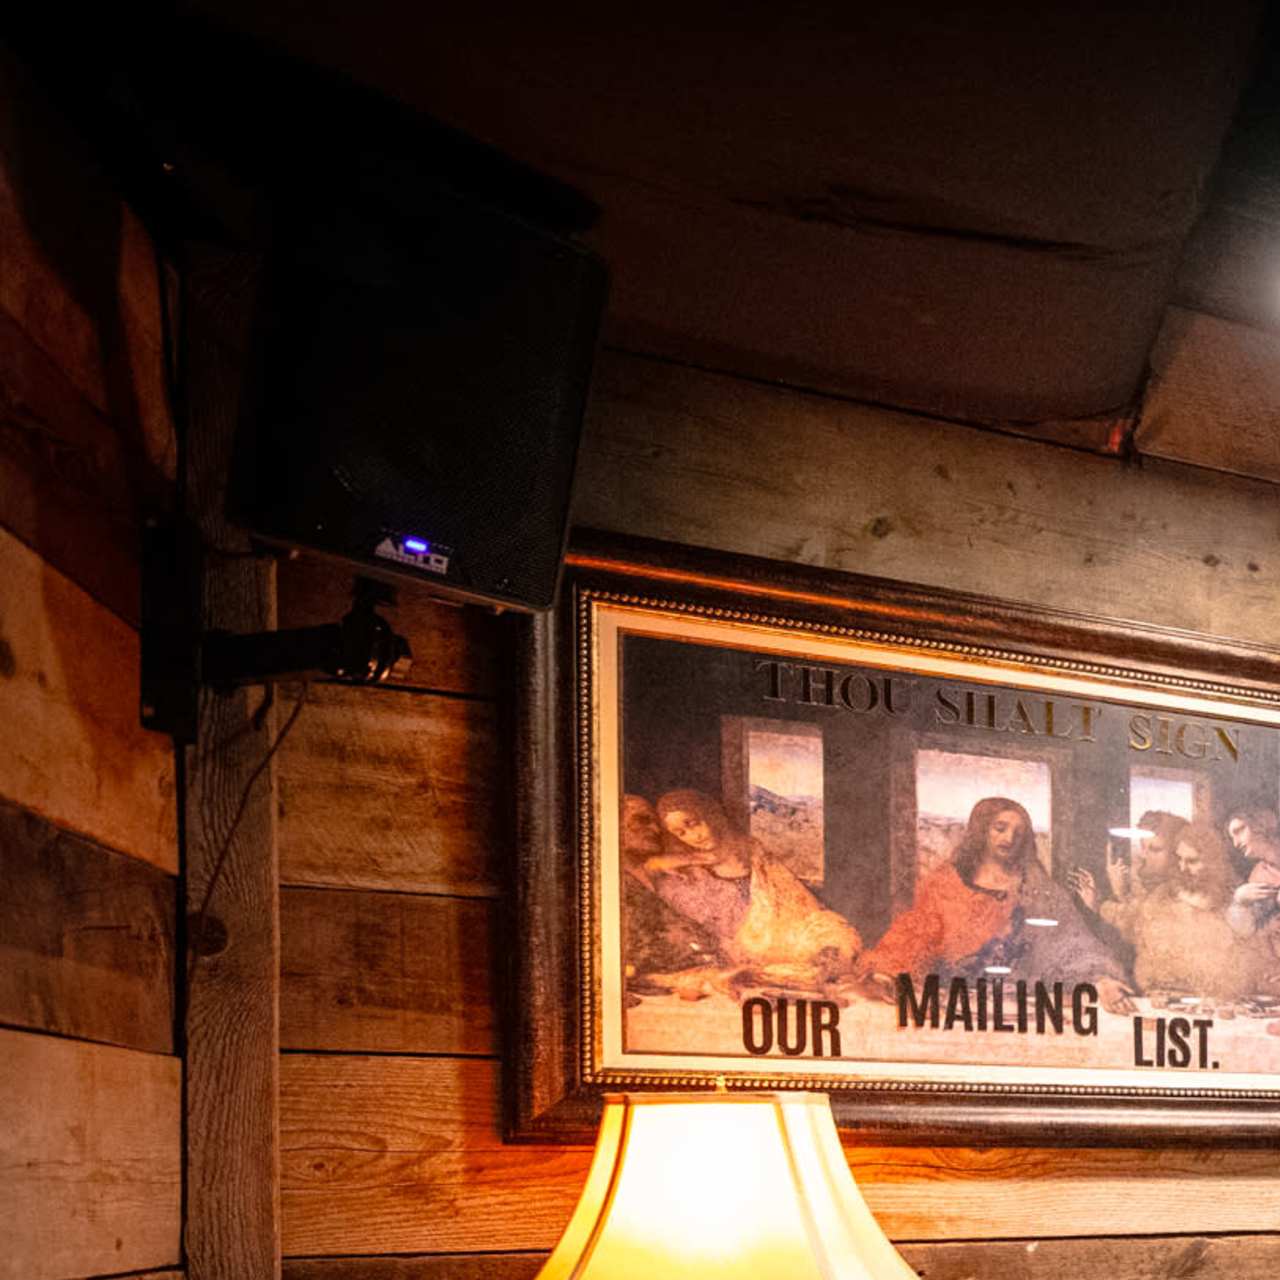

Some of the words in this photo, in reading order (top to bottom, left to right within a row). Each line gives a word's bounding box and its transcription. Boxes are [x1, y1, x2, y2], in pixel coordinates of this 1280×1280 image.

[755, 659, 917, 717] THOU
[934, 685, 1102, 742] SHALT
[1128, 712, 1241, 763] SIGN
[742, 997, 842, 1058] OUR
[897, 972, 1099, 1036] MAILING
[1133, 1016, 1220, 1069] LIST.
